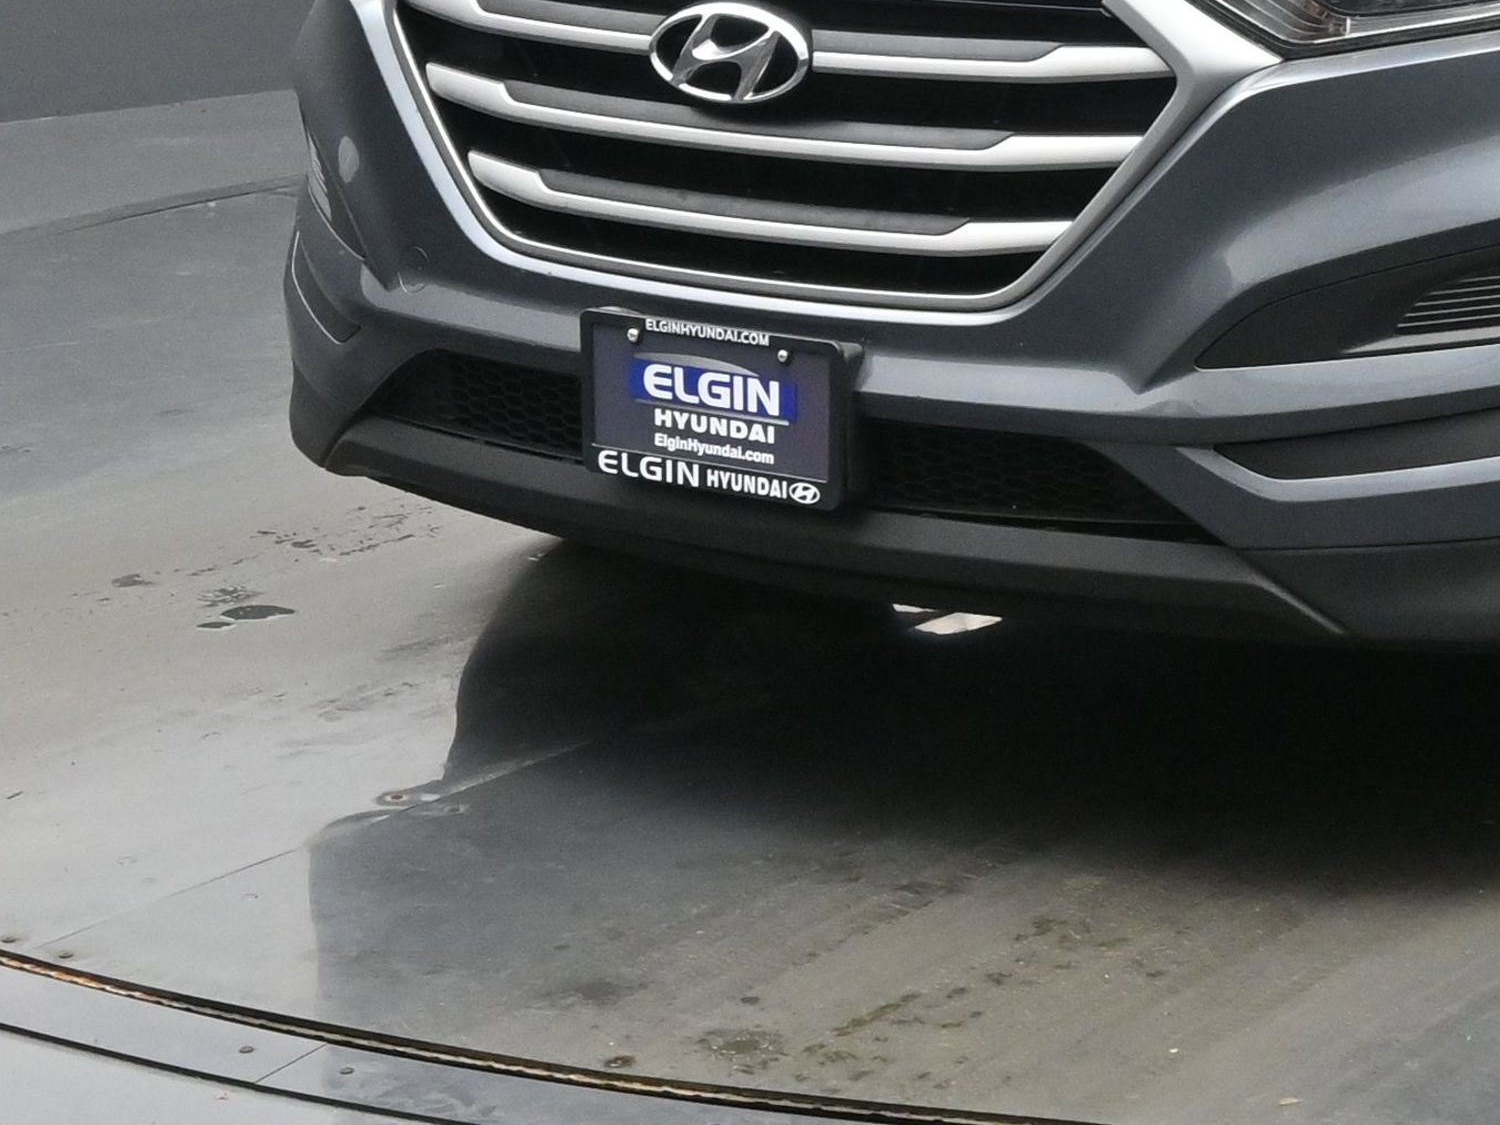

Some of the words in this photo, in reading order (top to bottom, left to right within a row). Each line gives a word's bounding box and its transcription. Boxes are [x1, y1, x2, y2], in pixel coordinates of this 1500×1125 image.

[645, 318, 769, 346] ELGINHYUNDAI.COM
[643, 364, 780, 416] ELGIN
[654, 408, 775, 444] HYUNDAI
[654, 433, 775, 464] ElginHyundai.com
[598, 450, 699, 487] ELGIN
[706, 468, 788, 499] HYUNDAI
